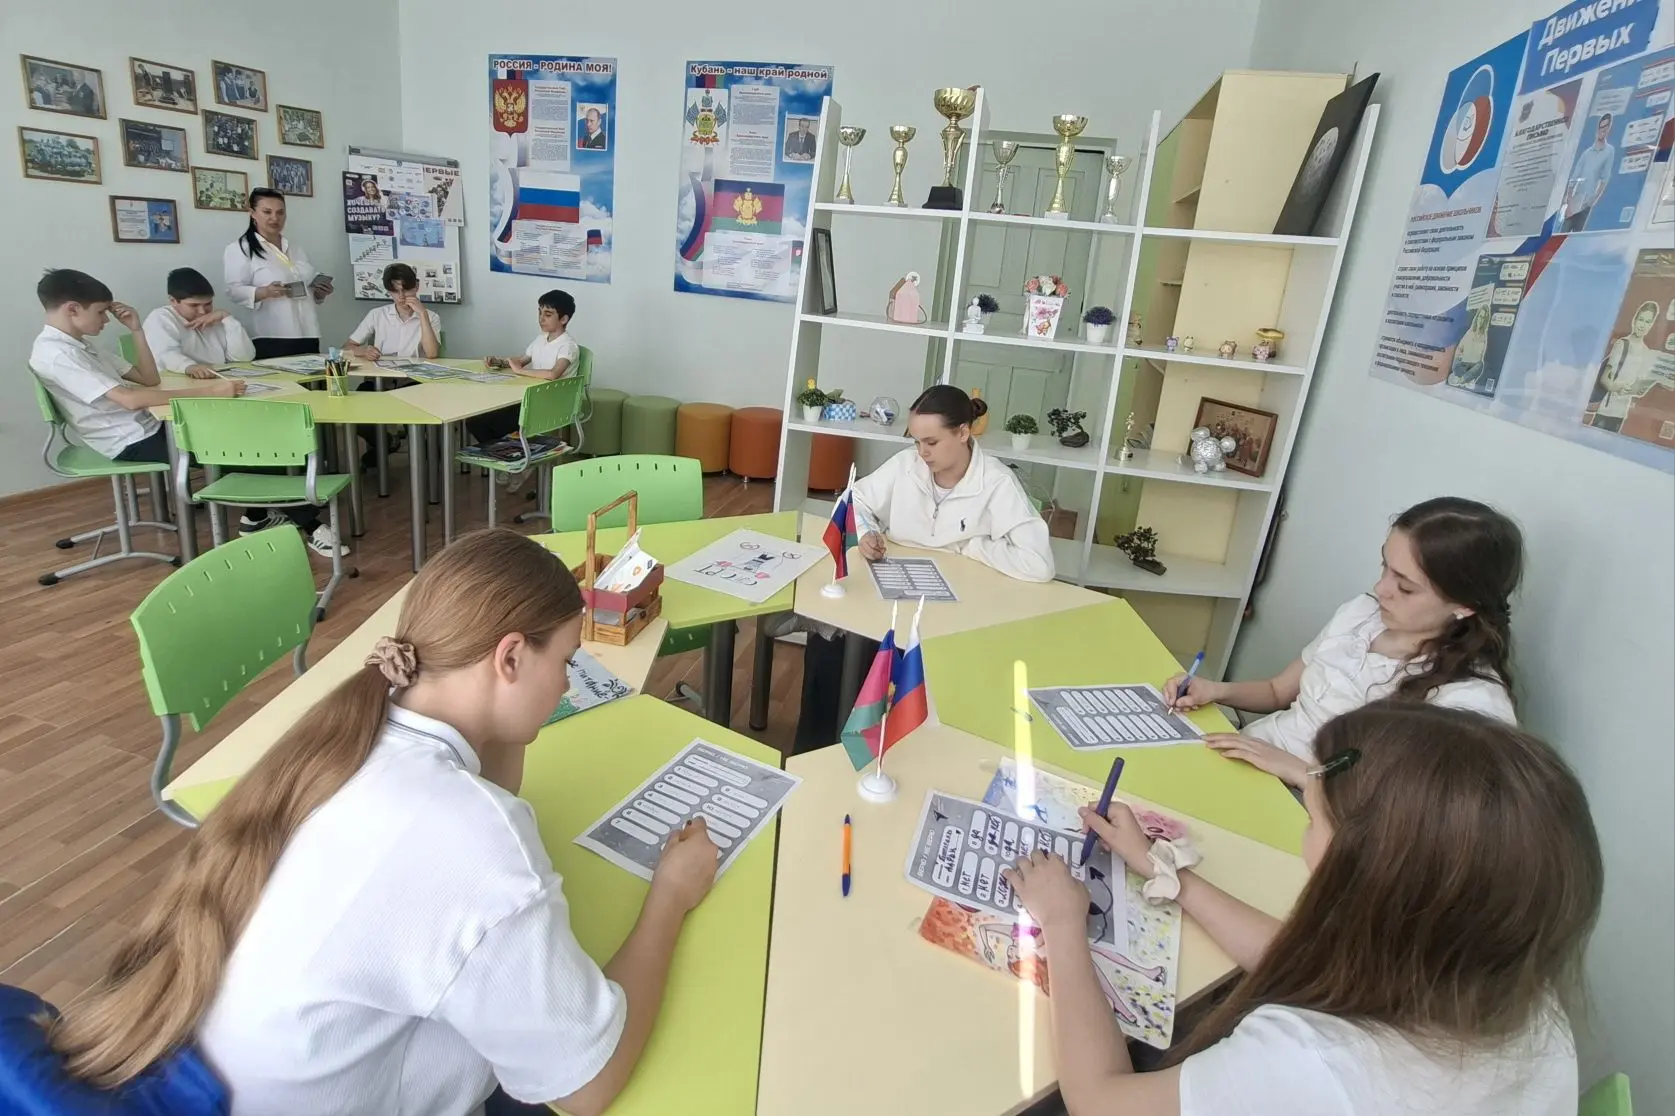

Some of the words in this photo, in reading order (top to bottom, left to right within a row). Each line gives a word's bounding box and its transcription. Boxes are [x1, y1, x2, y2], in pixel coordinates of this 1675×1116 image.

[1537, 0, 1642, 50] Движен
[1540, 22, 1636, 76] Первых
[493, 60, 532, 70] РОССИЯ
[540, 61, 582, 73] РОДИНА
[585, 63, 612, 73] МОЯ!
[690, 64, 725, 75] Кубань
[734, 67, 756, 75] наш
[759, 67, 785, 77] край
[787, 69, 827, 79] родной
[347, 206, 386, 214] СОЗДАВАТЬ
